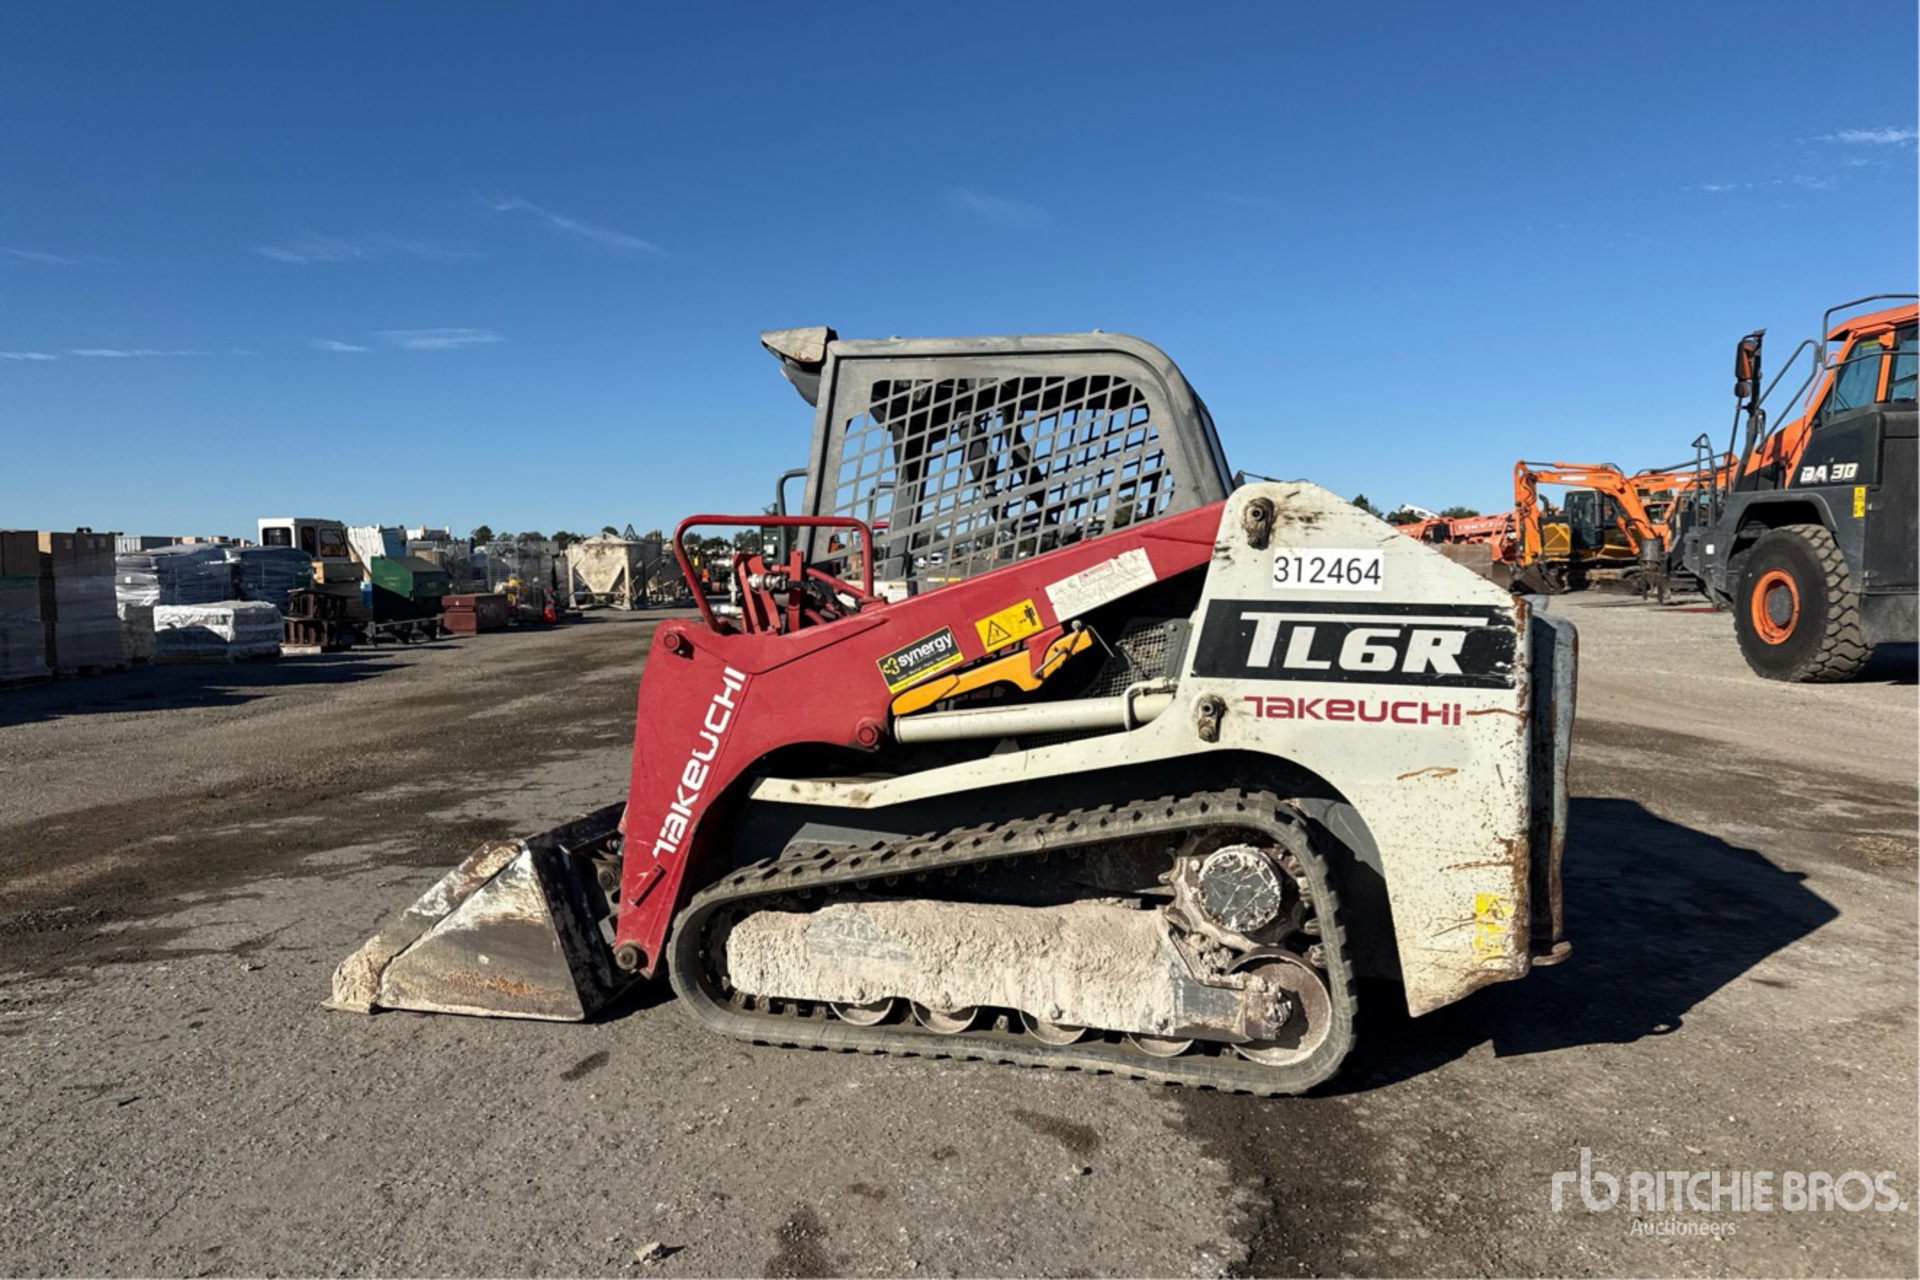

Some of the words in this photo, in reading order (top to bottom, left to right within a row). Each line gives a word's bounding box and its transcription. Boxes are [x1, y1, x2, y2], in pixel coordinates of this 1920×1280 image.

[1830, 462, 1859, 482] 30
[1273, 556, 1381, 585] 312464
[898, 632, 952, 667] synergy
[1240, 611, 1488, 675] TL6R
